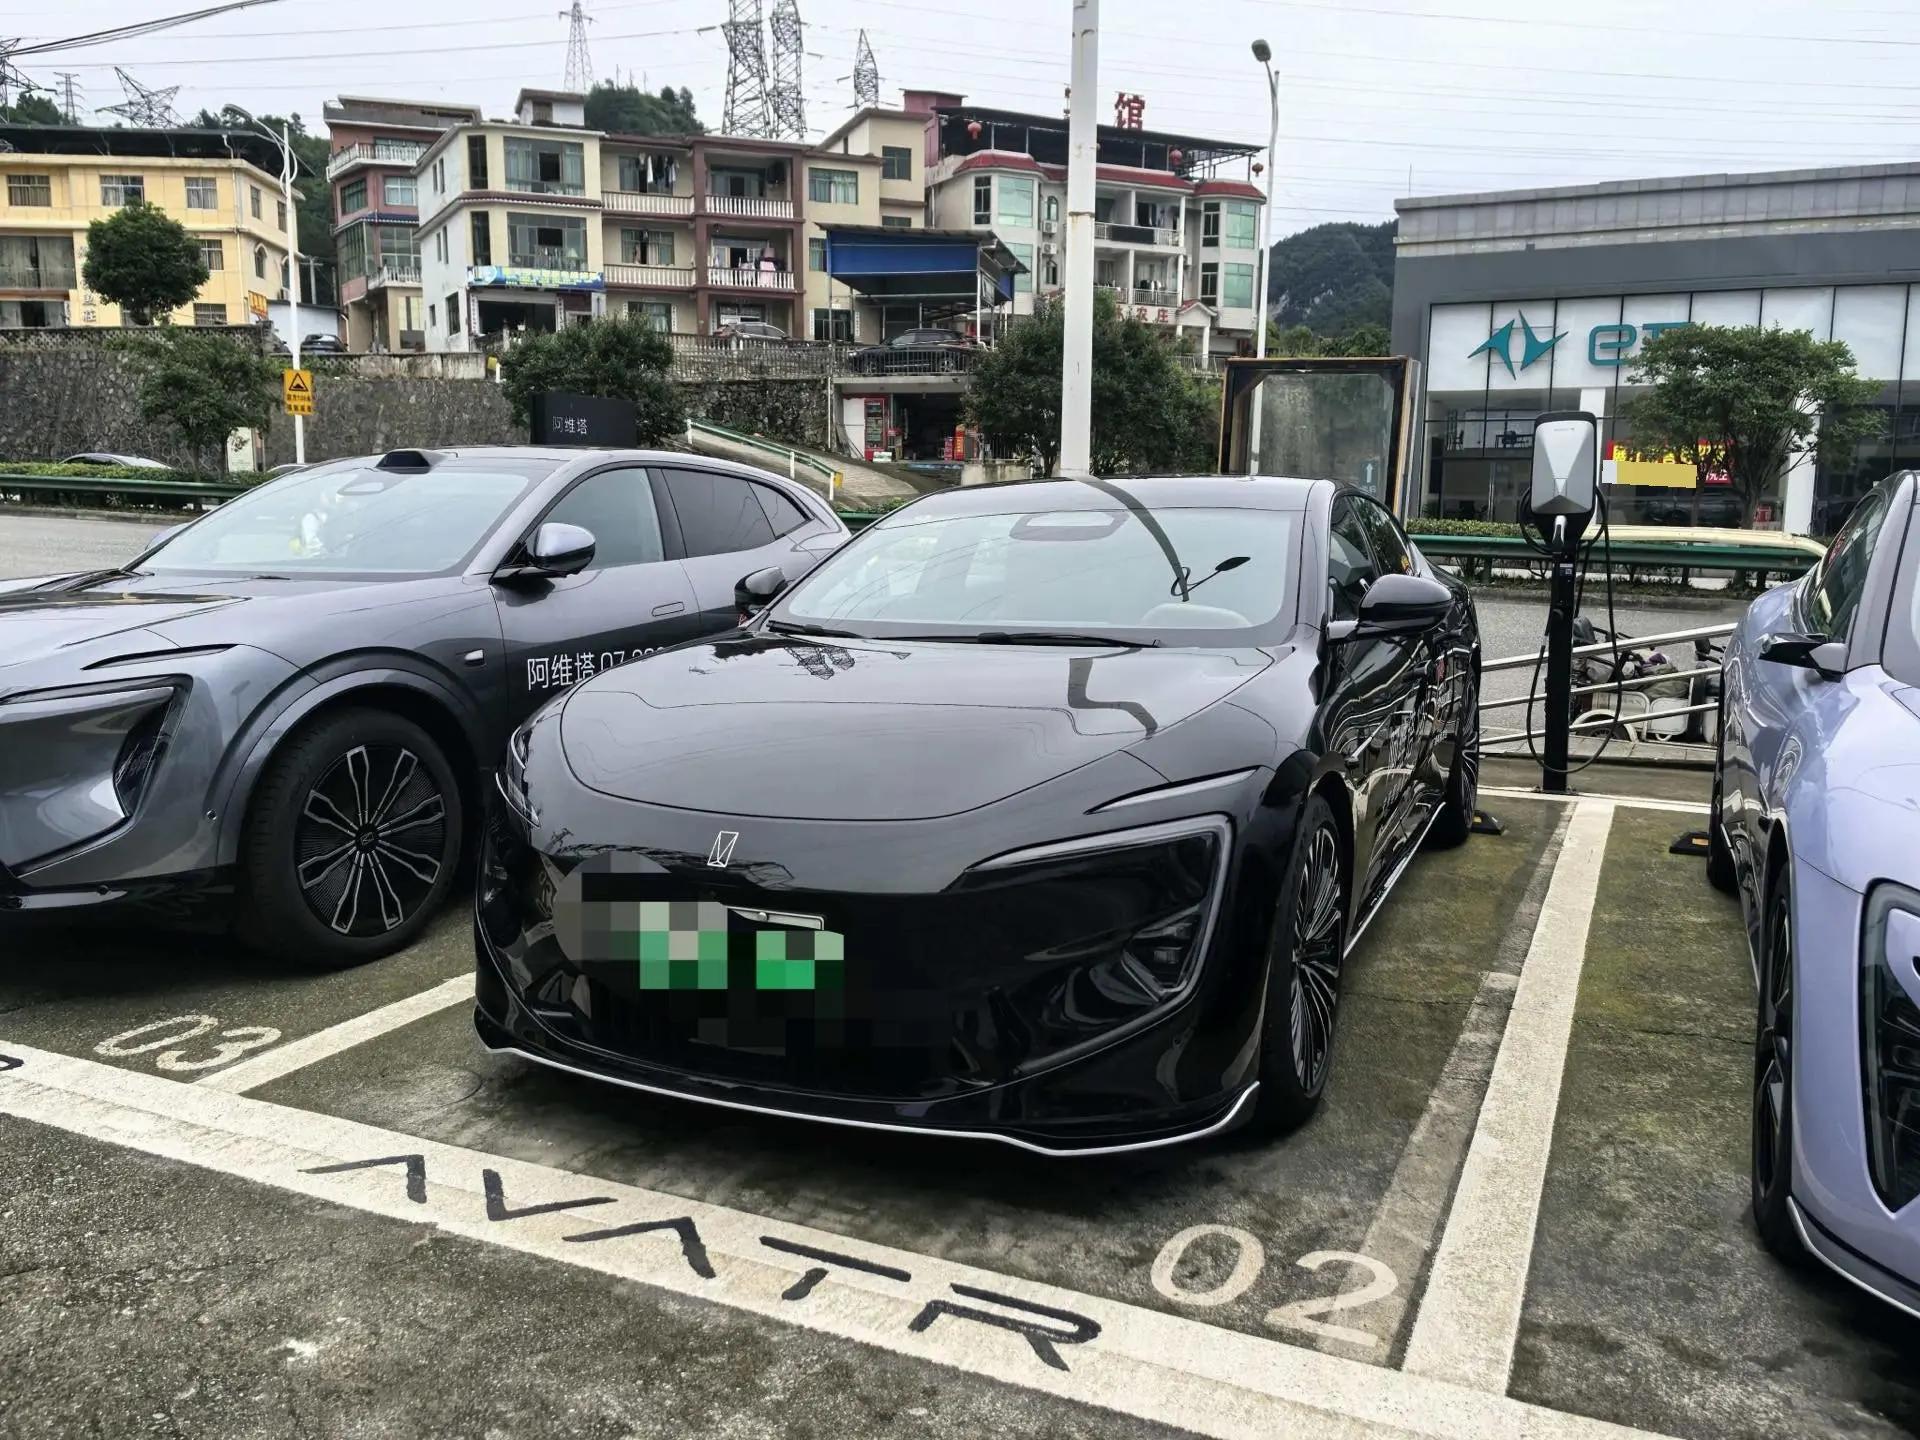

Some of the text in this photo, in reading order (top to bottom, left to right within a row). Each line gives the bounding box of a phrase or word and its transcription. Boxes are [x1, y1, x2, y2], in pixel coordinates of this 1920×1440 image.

[552, 415, 588, 435] 阿维塔
[527, 651, 595, 691] 阿维塔
[93, 1014, 281, 1072] 03
[297, 1154, 1102, 1371] AVATR
[1150, 1223, 1399, 1348] 02
